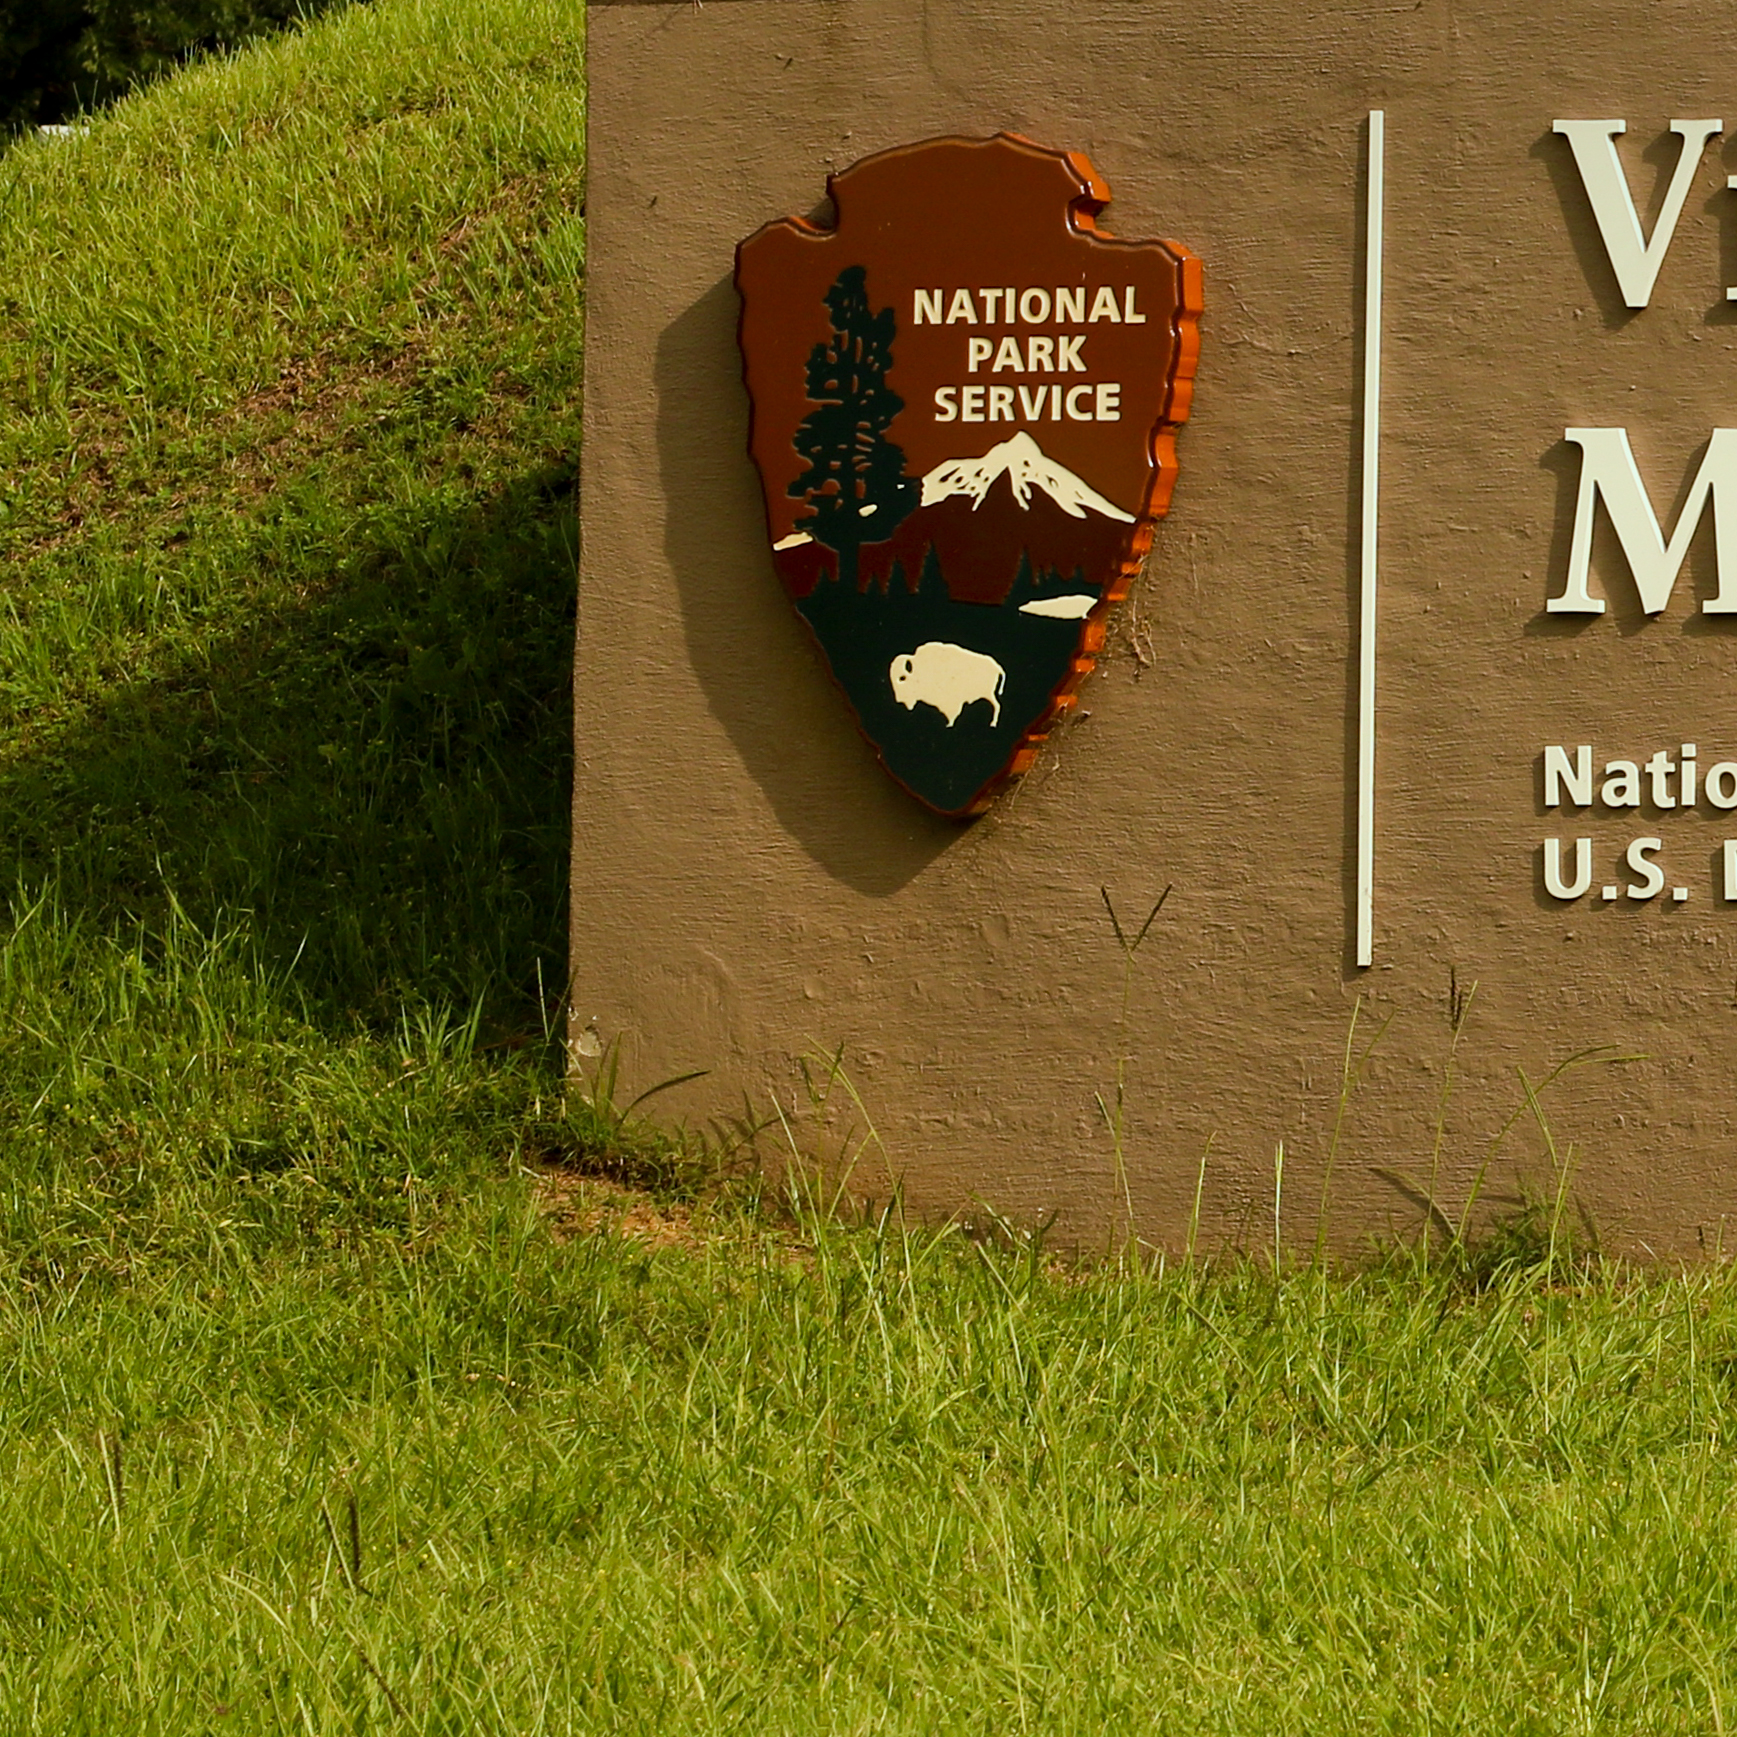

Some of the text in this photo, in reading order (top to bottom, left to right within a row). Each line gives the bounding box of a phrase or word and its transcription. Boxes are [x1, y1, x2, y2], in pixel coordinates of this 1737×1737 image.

[914, 287, 1145, 324] NATIONAL
[969, 336, 1086, 372] PARK
[935, 384, 1120, 421] SERVICE
[1545, 837, 1688, 900] U.S.
